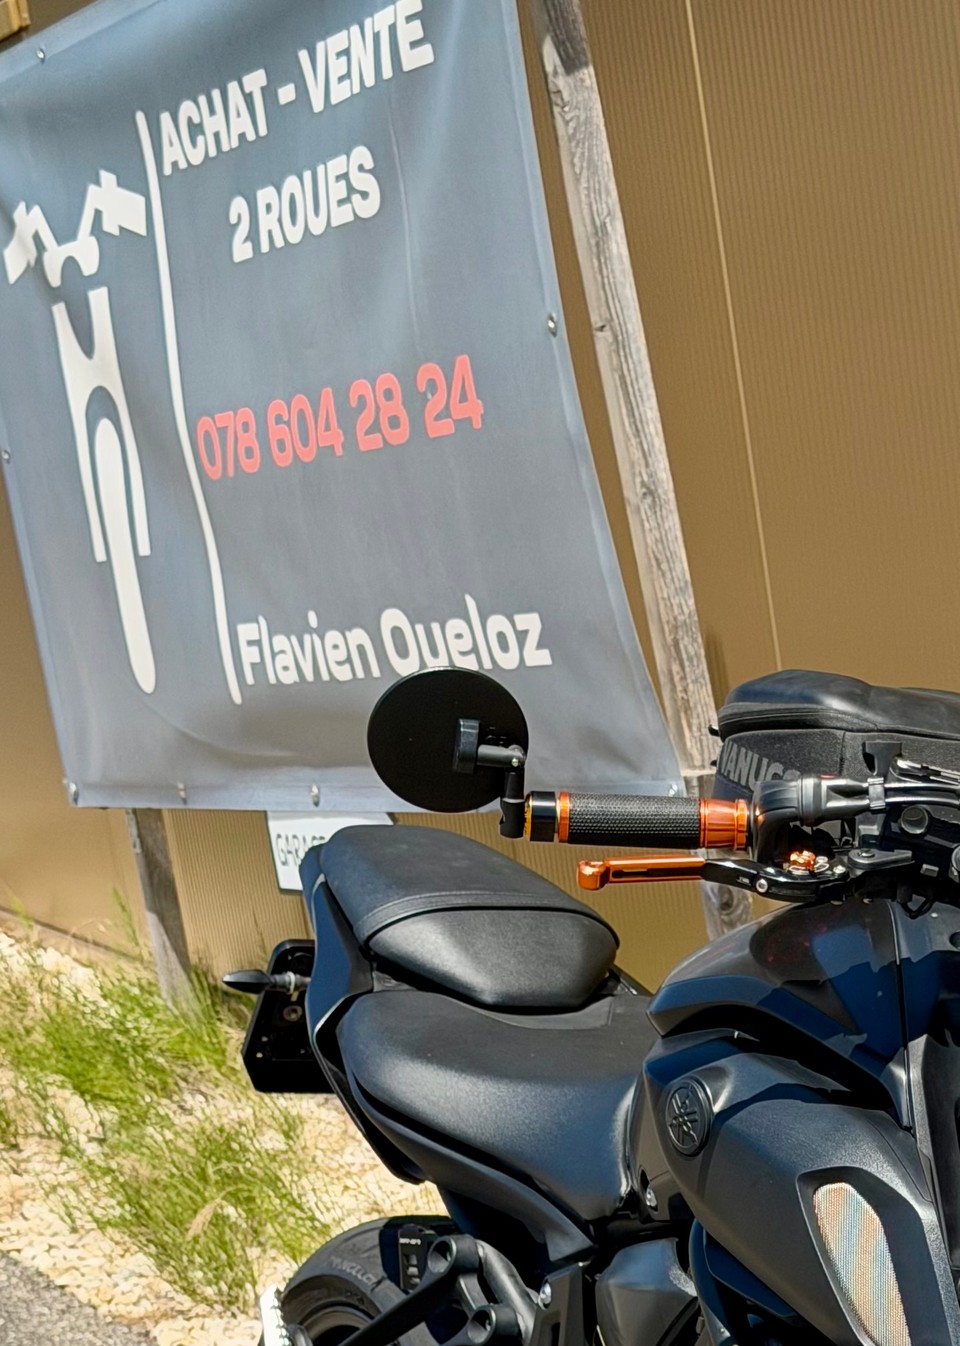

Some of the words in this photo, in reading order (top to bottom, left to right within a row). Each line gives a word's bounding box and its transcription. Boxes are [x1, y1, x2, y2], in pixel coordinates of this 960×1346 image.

[160, 68, 268, 176] ACHAT
[298, 0, 434, 113] VENTE
[229, 196, 253, 263] 2
[257, 145, 381, 253] ROUES
[196, 407, 261, 481] 078
[267, 387, 344, 467] 604
[349, 367, 410, 452] 28
[416, 354, 484, 439] 24
[237, 610, 381, 685] Flavien
